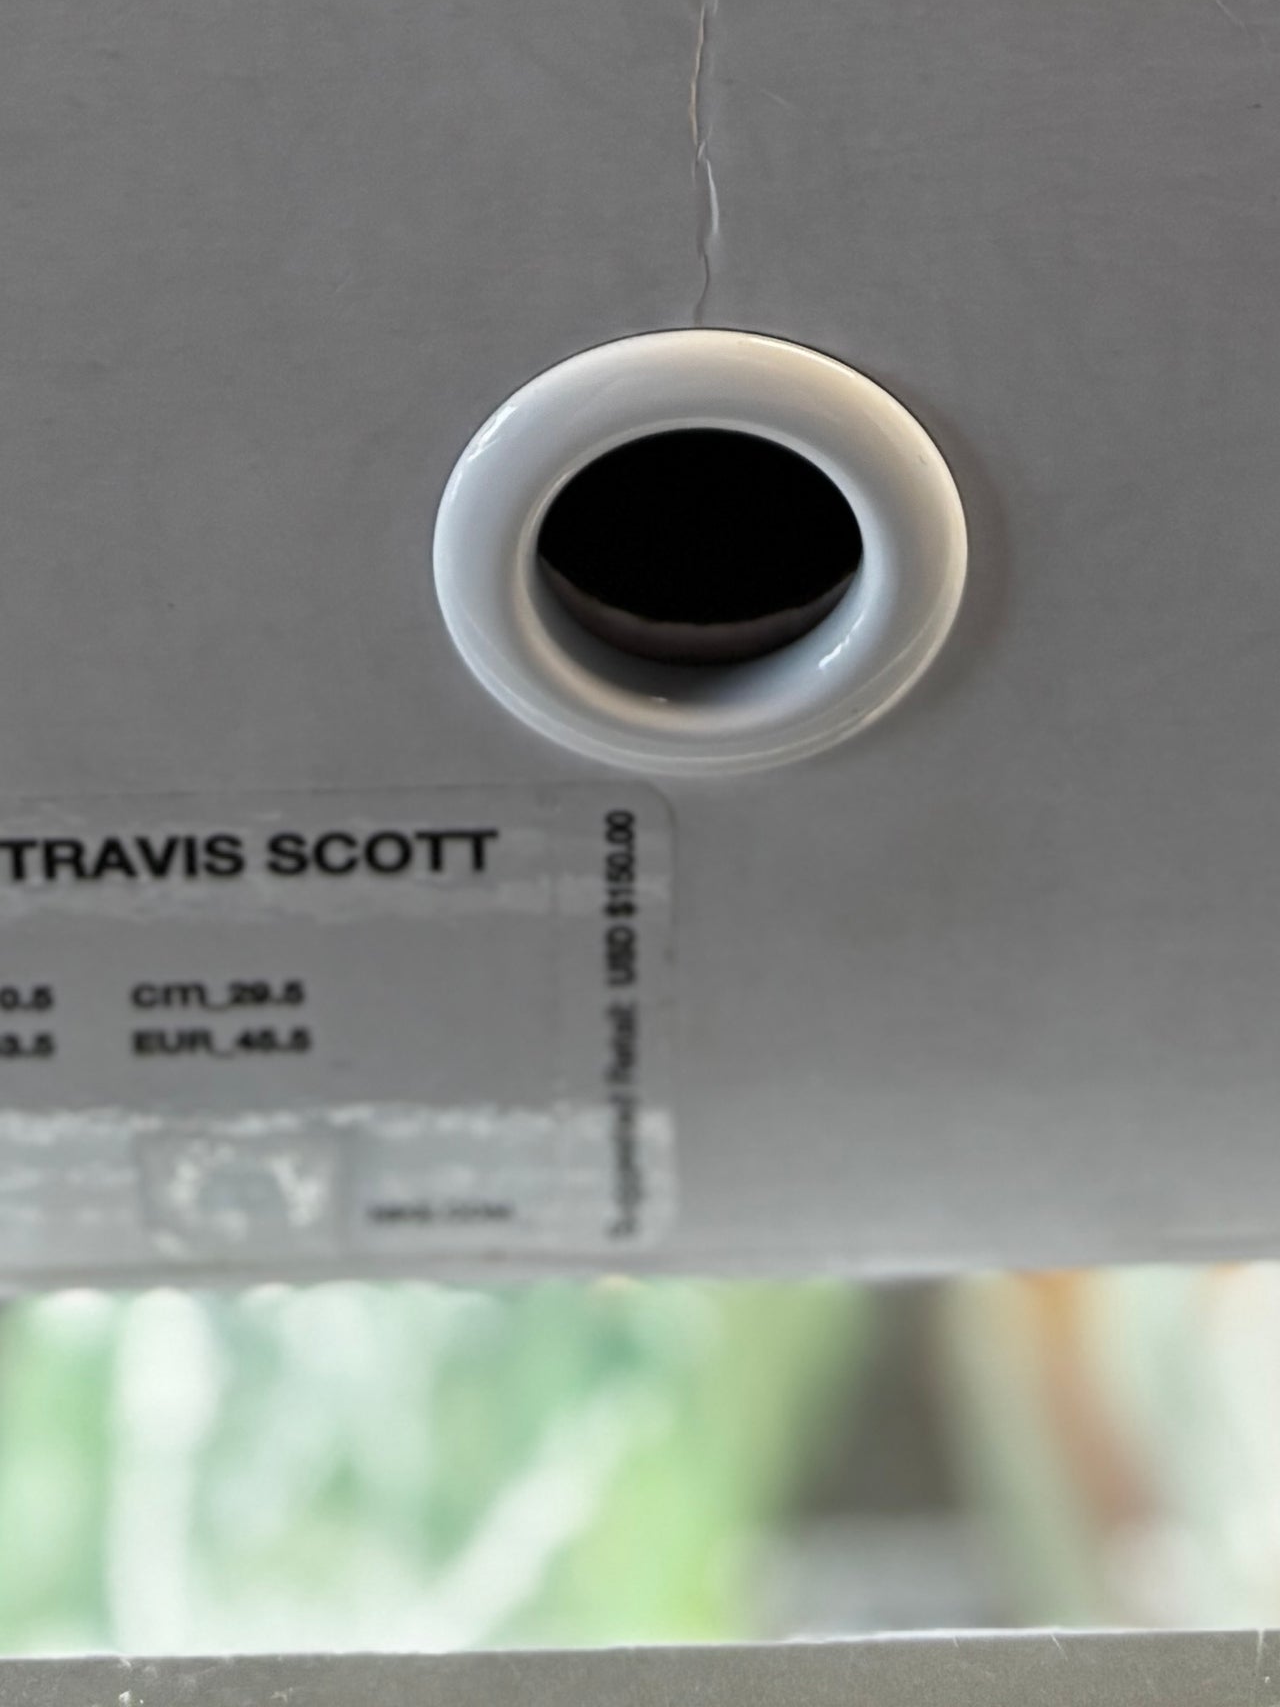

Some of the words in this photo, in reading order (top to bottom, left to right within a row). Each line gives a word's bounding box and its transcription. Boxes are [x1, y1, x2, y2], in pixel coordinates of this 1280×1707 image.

[266, 828, 499, 877] SCOTT
[603, 808, 638, 920] $150.00
[603, 923, 638, 988] USD
[131, 1027, 312, 1060] EUR_45.5
